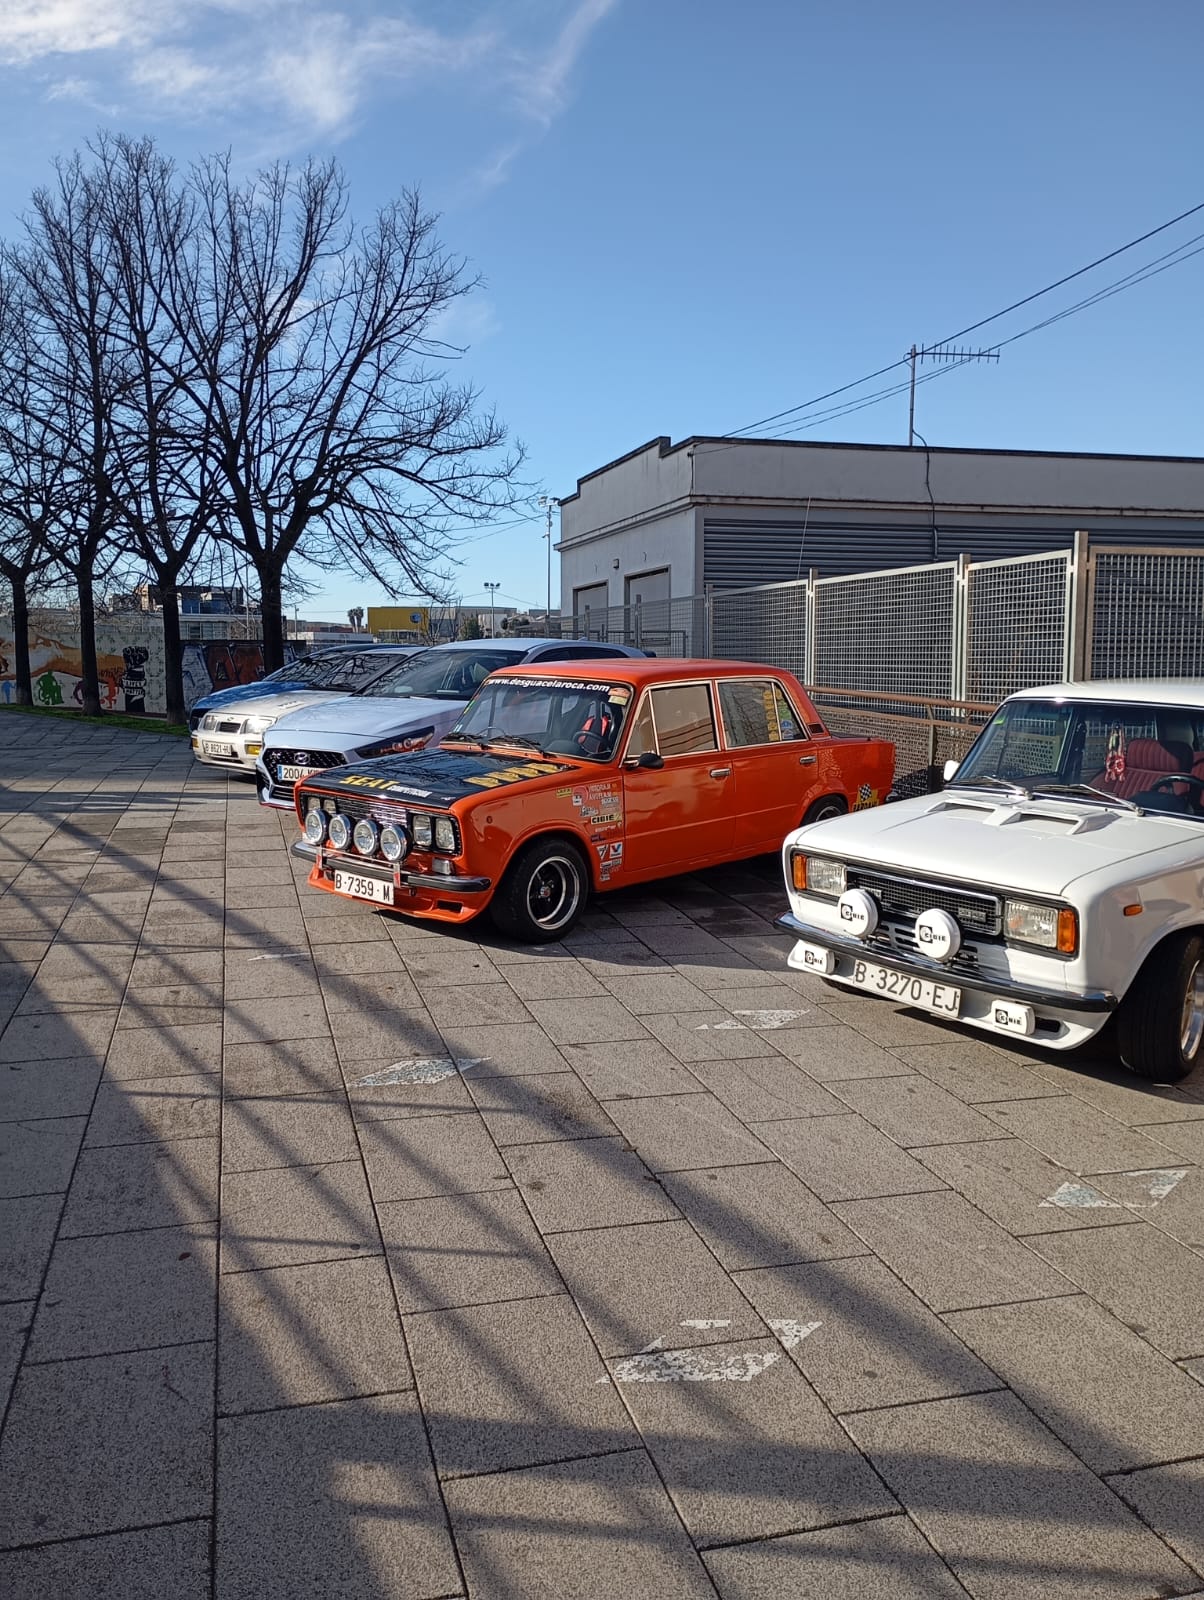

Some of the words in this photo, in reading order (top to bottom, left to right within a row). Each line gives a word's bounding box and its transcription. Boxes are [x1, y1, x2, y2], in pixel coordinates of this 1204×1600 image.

[488, 677, 610, 692] www.desguacelaroca.com
[338, 775, 400, 789] SEAT
[591, 814, 615, 824] CIBIE
